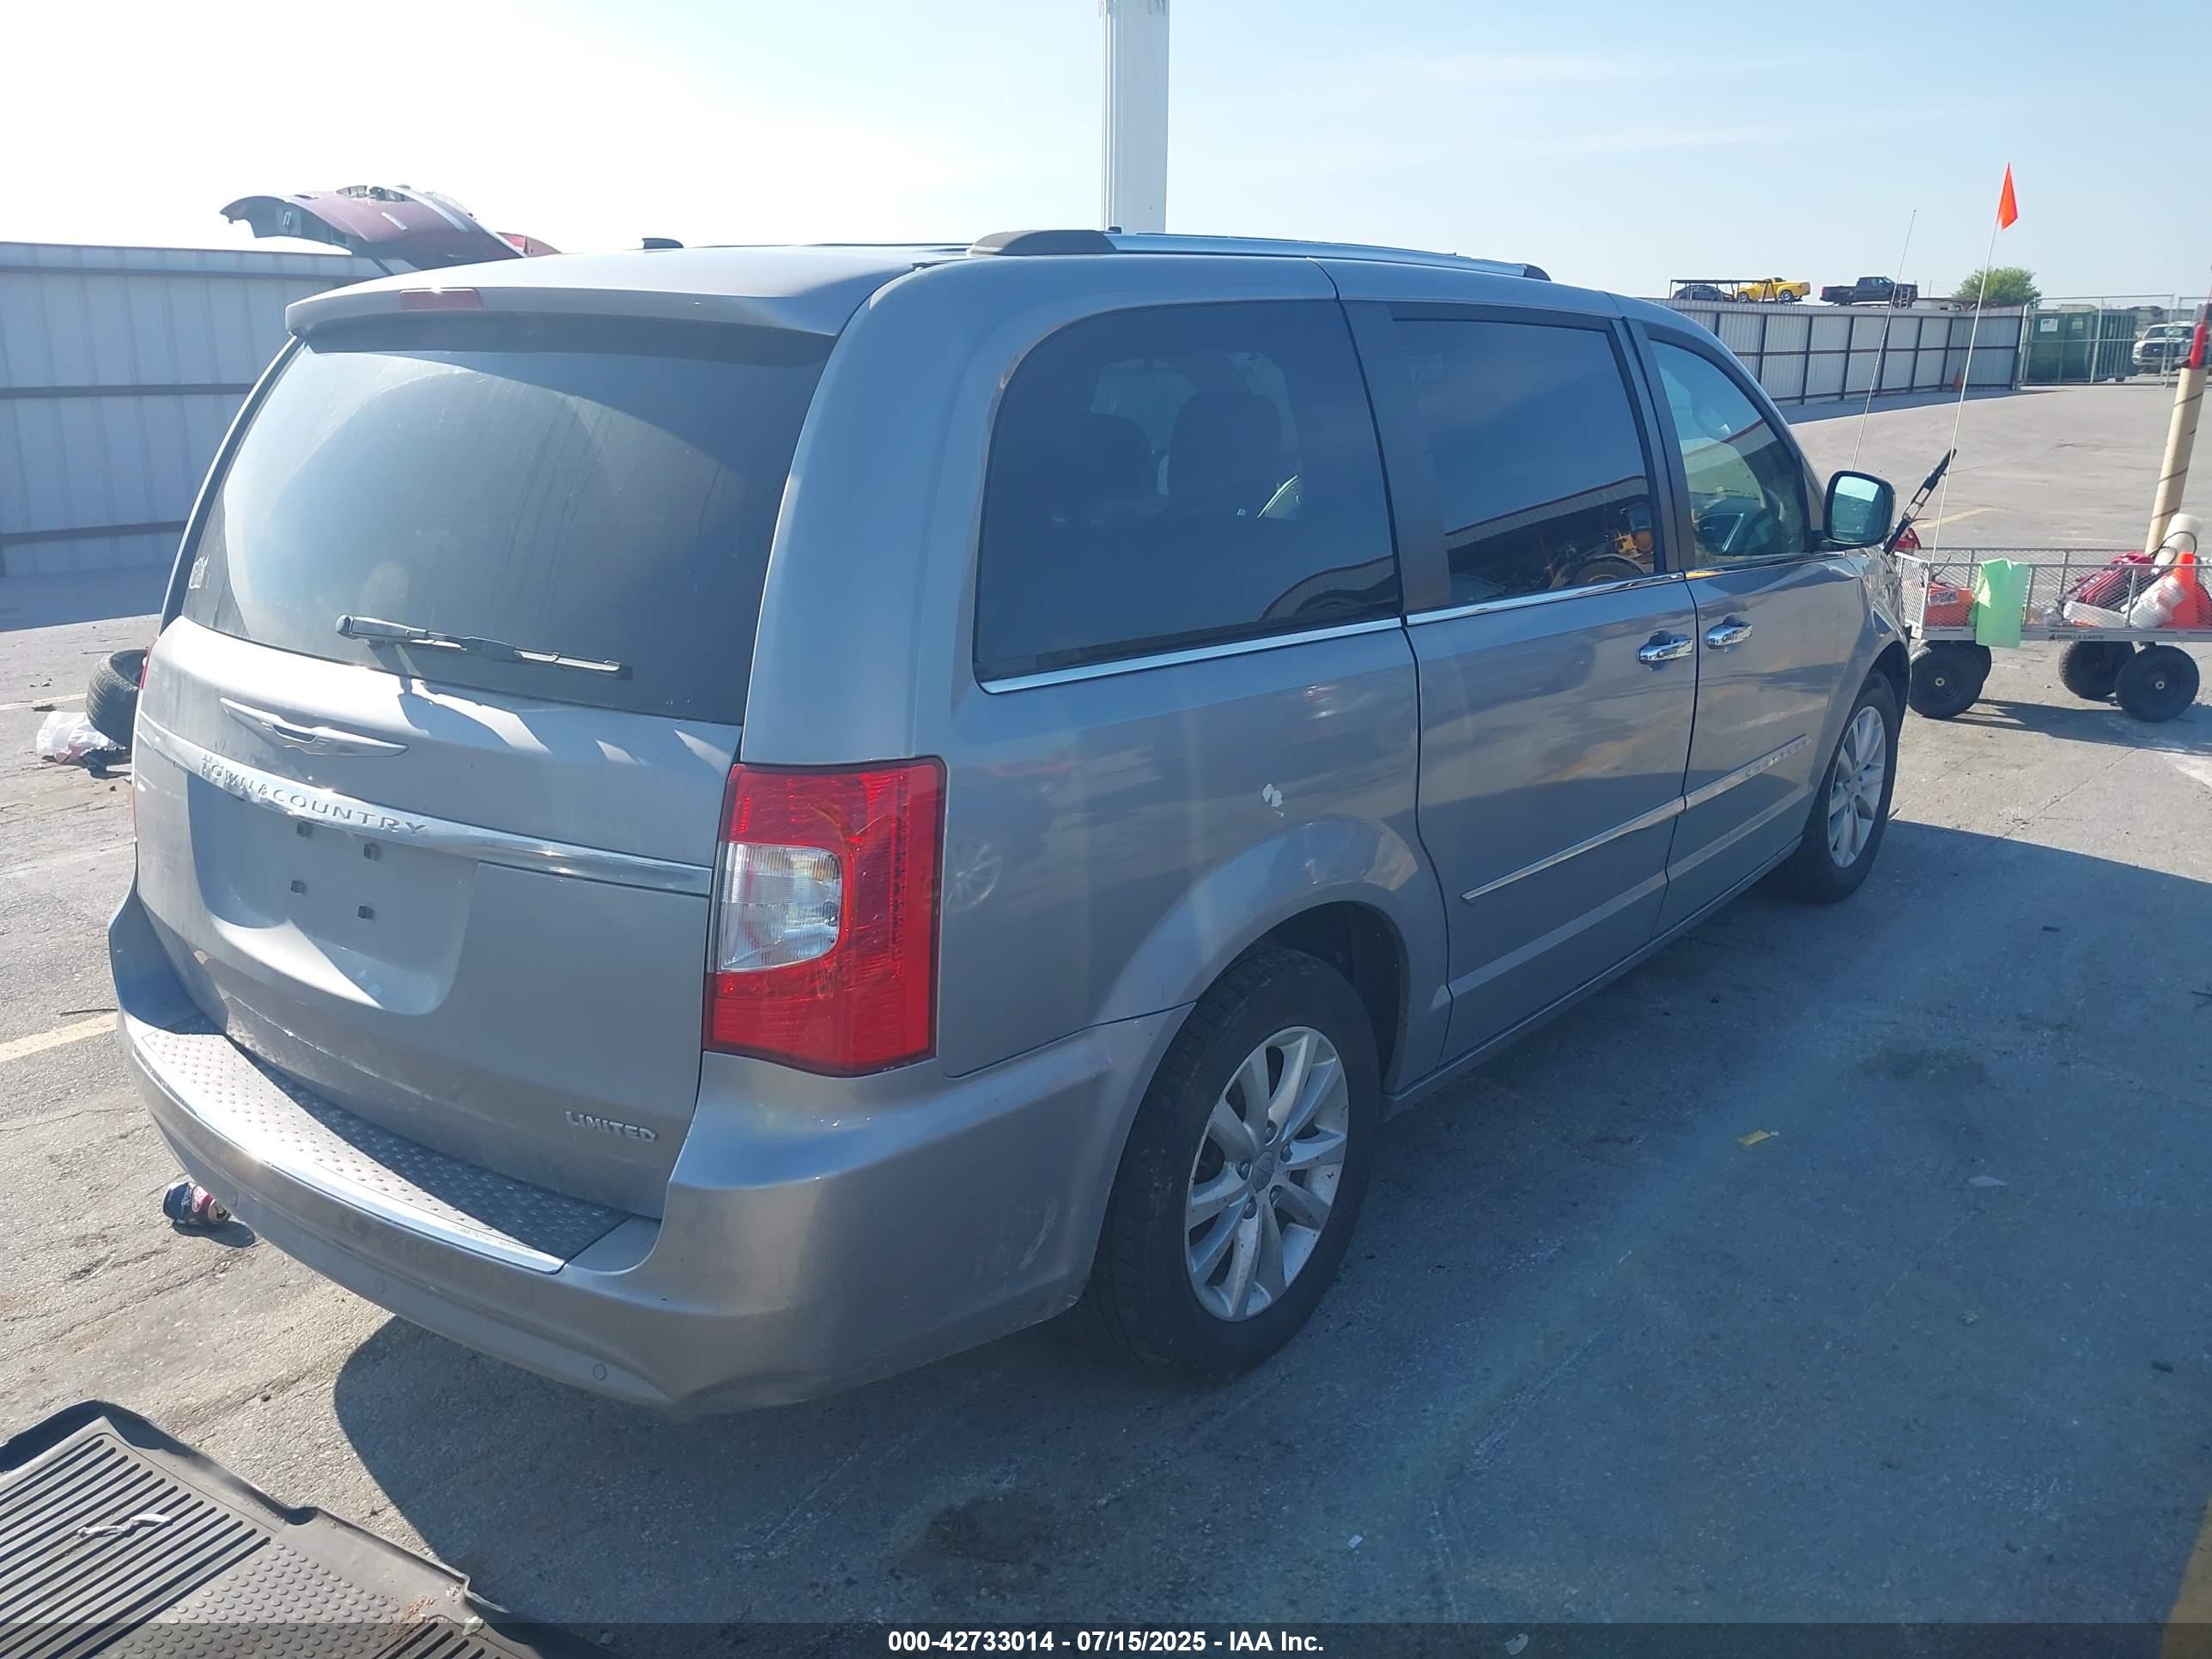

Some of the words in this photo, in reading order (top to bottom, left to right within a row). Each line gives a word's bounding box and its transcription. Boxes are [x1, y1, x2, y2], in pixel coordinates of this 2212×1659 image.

[201, 754, 255, 793] TOWN
[258, 783, 268, 798] &
[272, 788, 427, 836] COUNTRY
[564, 1110, 658, 1143] LIMITED
